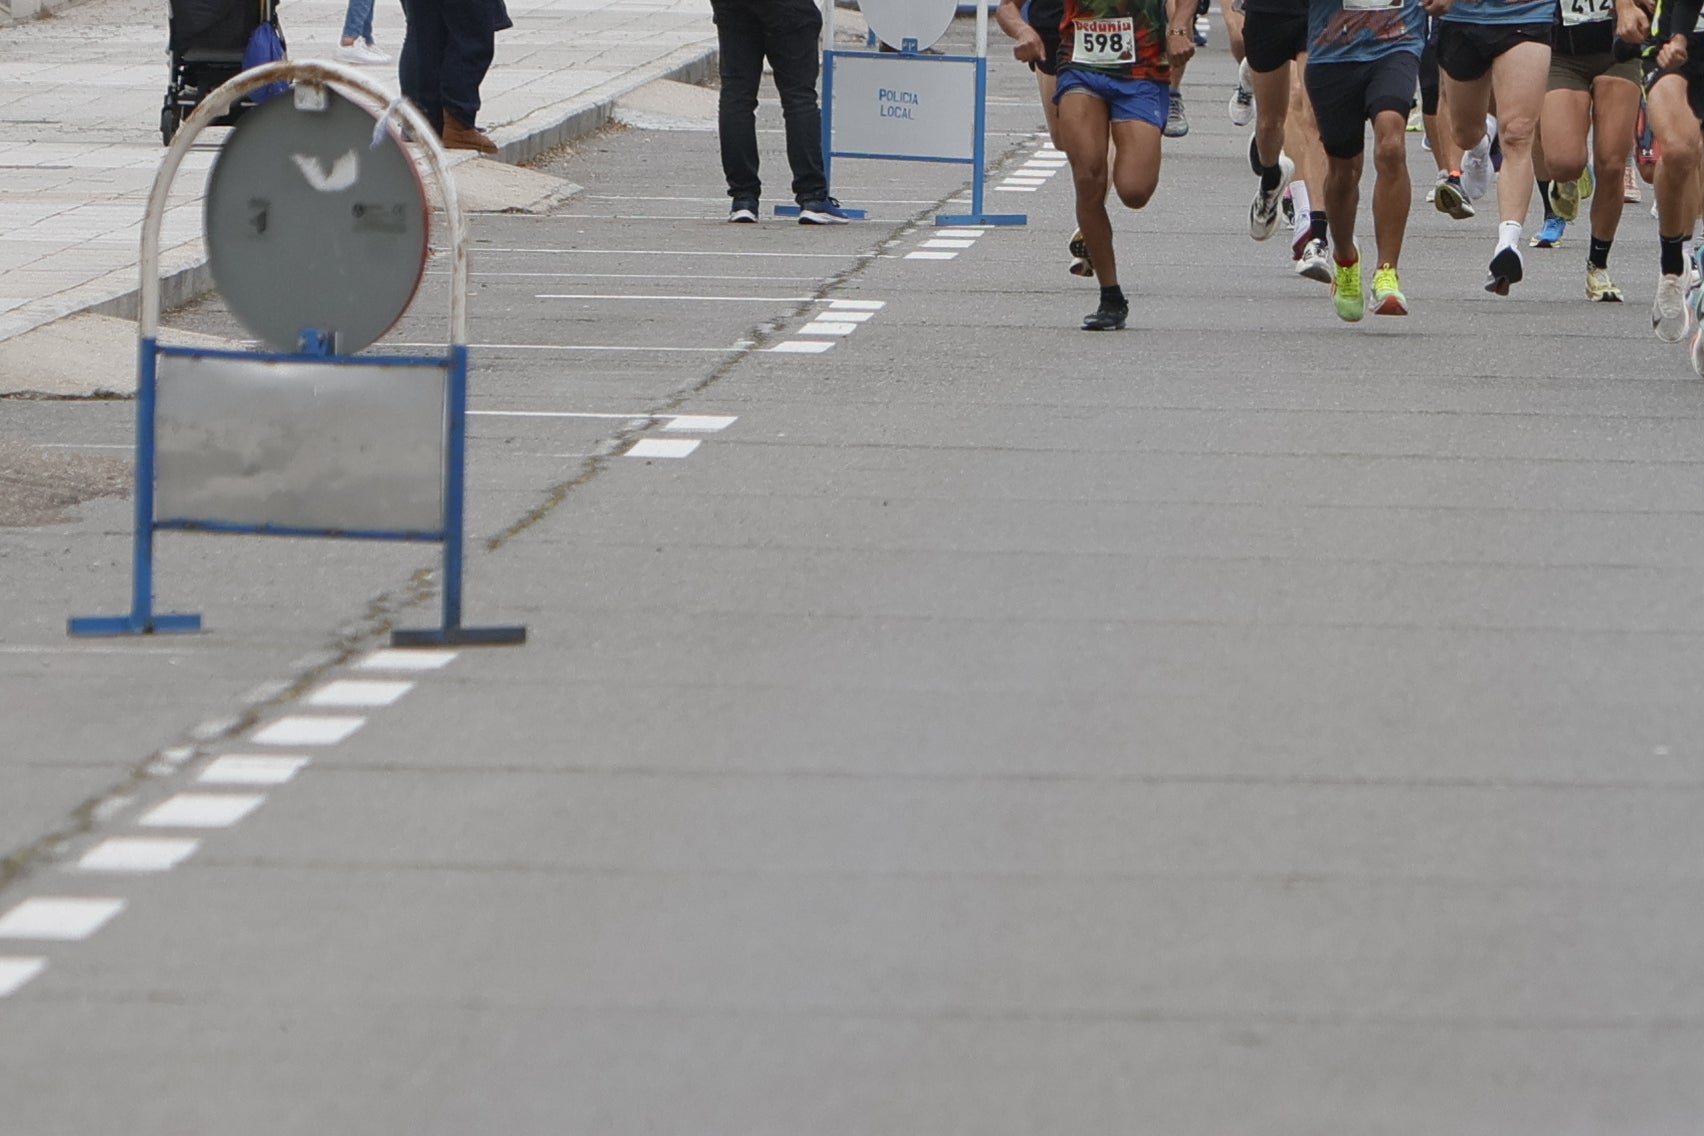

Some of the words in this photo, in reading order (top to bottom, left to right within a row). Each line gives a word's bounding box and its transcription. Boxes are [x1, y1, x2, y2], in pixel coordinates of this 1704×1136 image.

[1075, 21, 1132, 33] bedunia
[1083, 33, 1123, 53] 598
[879, 88, 919, 105] POLICIA
[880, 104, 915, 121] LOCAL
